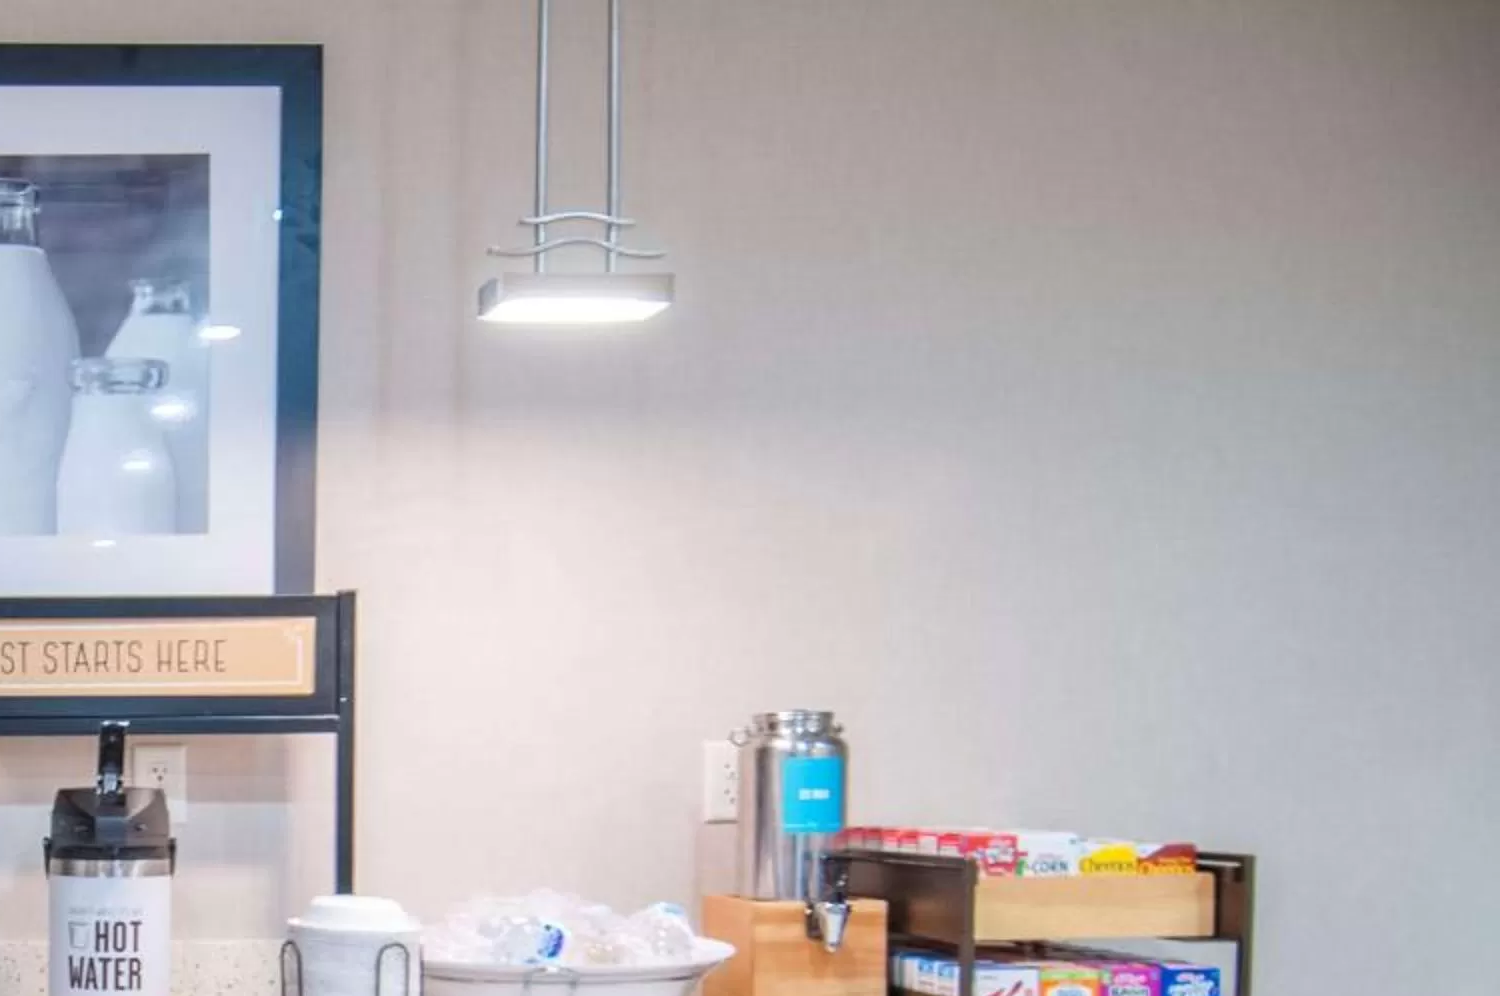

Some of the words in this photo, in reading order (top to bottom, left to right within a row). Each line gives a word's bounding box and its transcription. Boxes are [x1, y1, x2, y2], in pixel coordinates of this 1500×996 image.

[42, 640, 144, 674] STARTS
[156, 638, 228, 673] HERE
[95, 920, 142, 952] HOT
[68, 955, 142, 990] WATER
